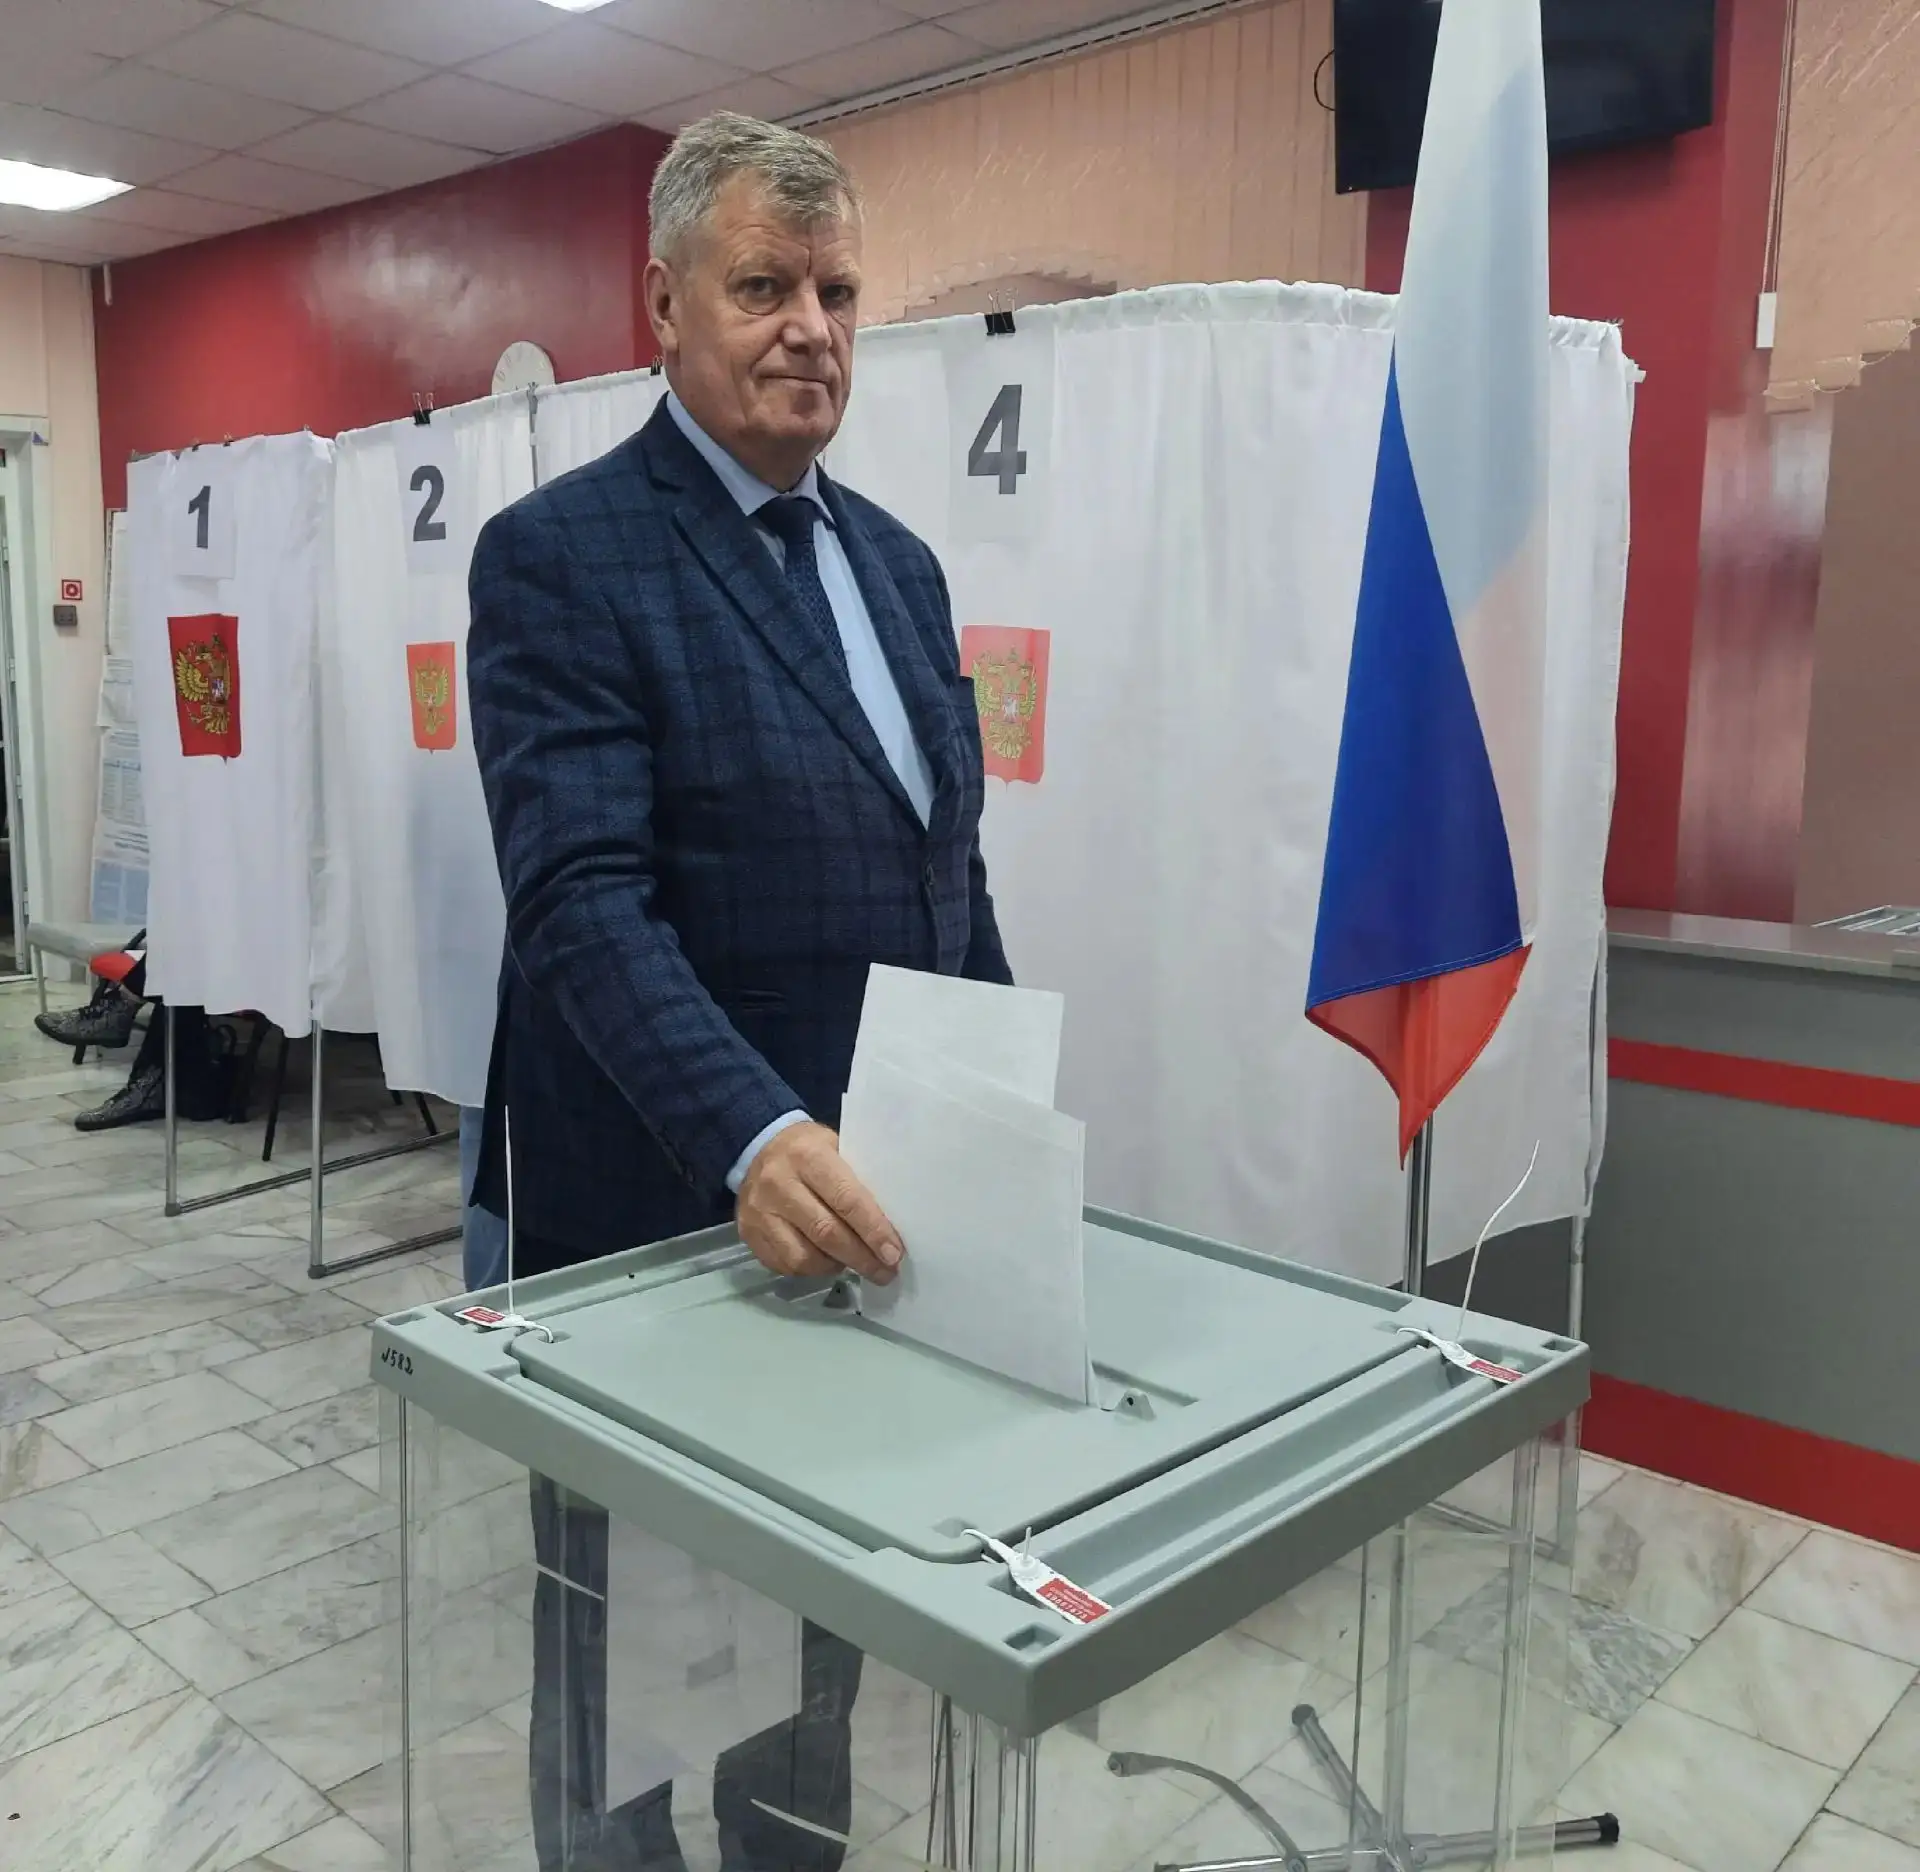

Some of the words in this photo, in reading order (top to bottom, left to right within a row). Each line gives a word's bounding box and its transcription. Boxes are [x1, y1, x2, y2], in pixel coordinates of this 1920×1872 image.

[968, 384, 1027, 495] 4
[187, 485, 212, 549] 1
[409, 465, 447, 542] 2
